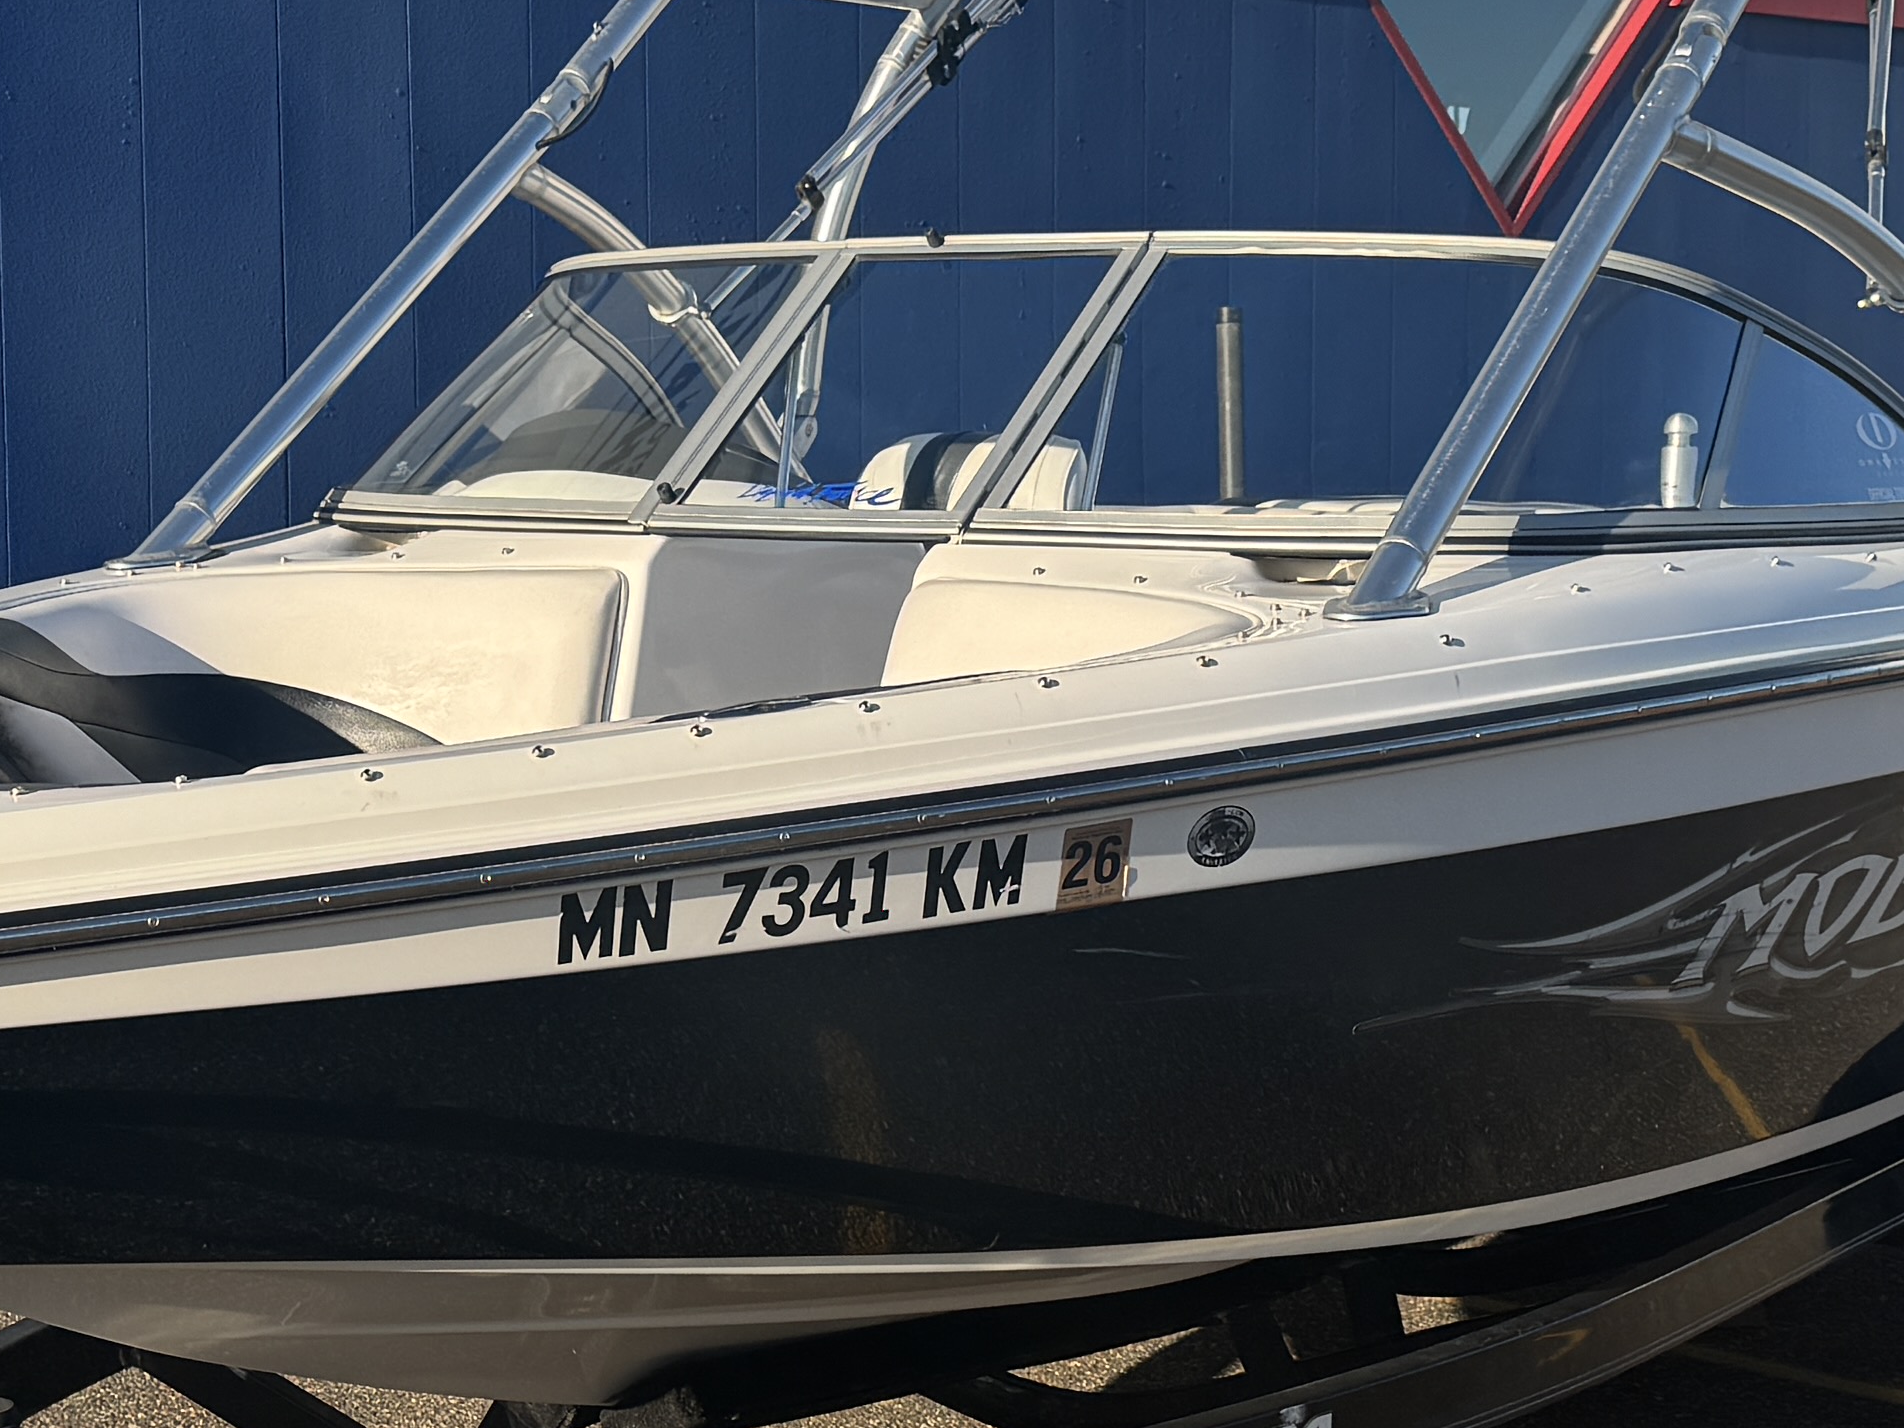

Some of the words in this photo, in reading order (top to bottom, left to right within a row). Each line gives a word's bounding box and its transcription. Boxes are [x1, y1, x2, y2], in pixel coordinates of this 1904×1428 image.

[557, 878, 674, 966] MN
[717, 849, 890, 946] 7341
[921, 833, 1029, 920] KM
[1061, 834, 1124, 890] 26
